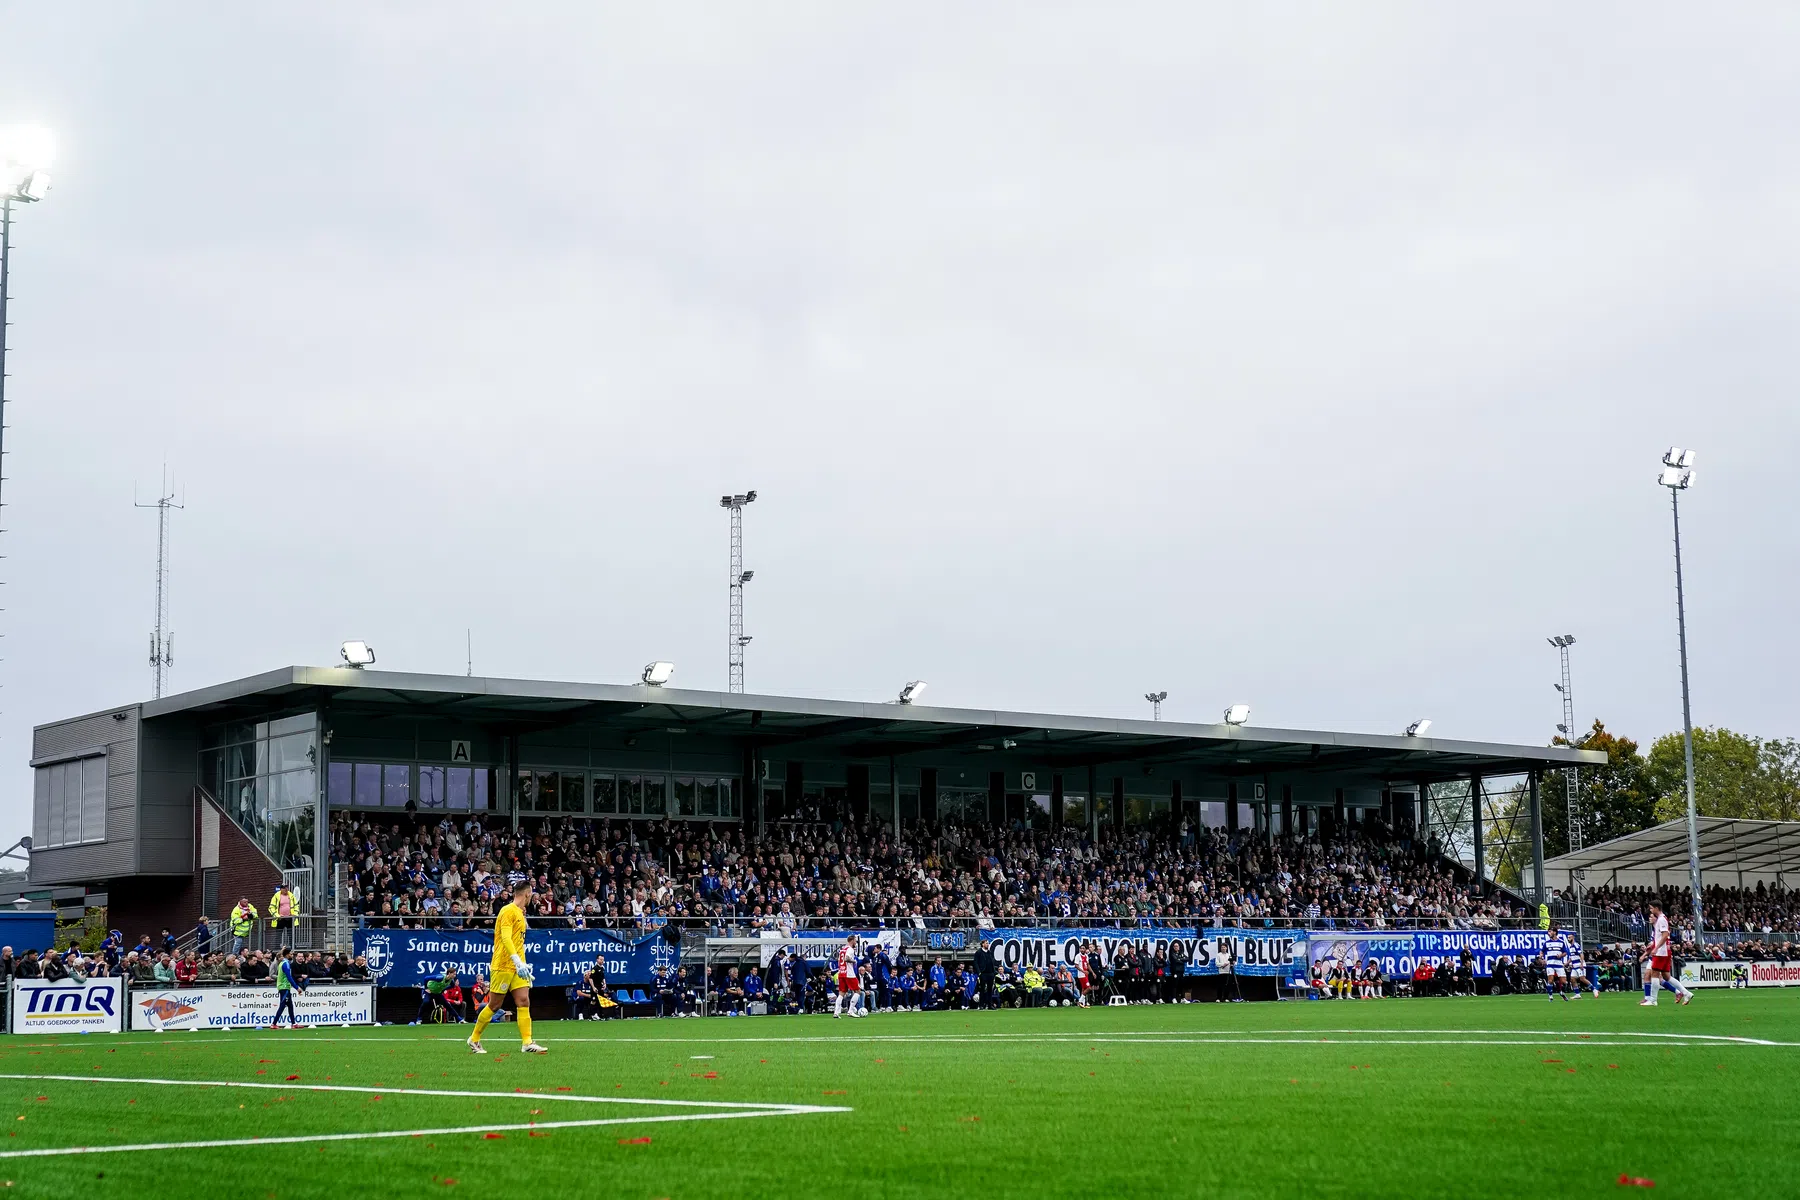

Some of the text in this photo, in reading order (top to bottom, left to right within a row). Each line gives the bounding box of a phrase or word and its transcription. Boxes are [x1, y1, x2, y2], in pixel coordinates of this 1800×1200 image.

[454, 742, 468, 760] A
[1024, 773, 1034, 789] C
[1256, 785, 1265, 798] D
[407, 937, 459, 953] Samen
[1418, 934, 1442, 951] TIP:
[989, 938, 1057, 969] COME
[1244, 937, 1293, 966] BLUE
[416, 960, 438, 974] SV
[1700, 964, 1749, 982] Ameronn
[304, 990, 358, 998] Raamdecoraties
[143, 994, 203, 1017] van Dalfsen
[294, 1000, 321, 1008] Vloeren
[328, 1000, 347, 1008] Tapijt
[162, 1013, 199, 1028] Woonmarket
